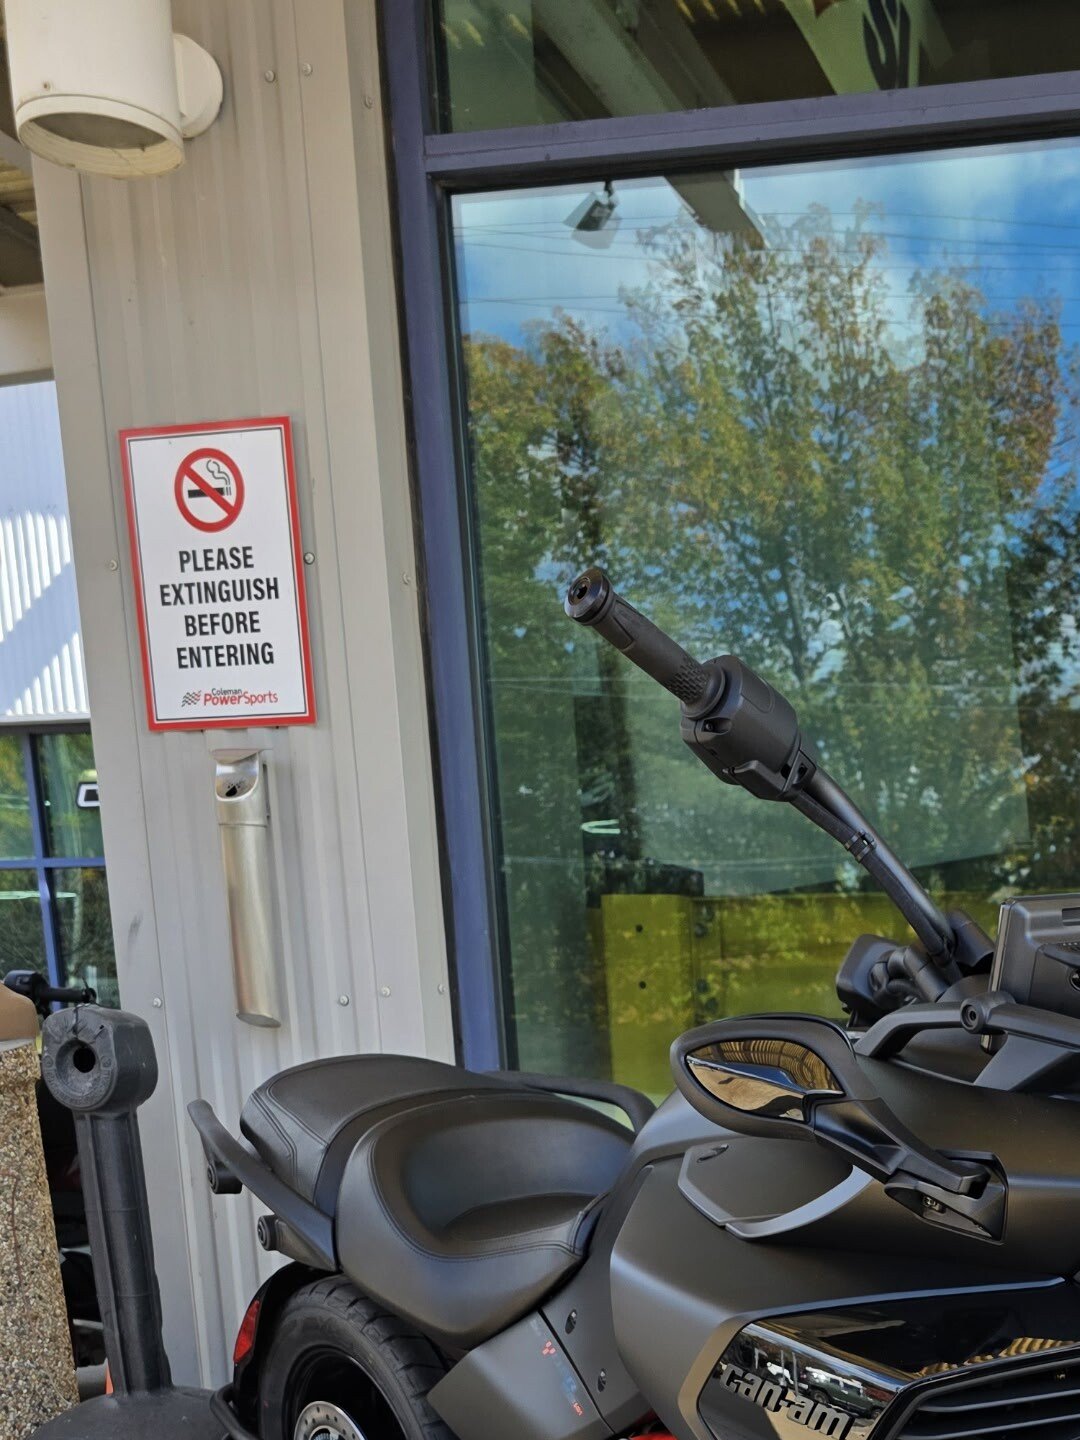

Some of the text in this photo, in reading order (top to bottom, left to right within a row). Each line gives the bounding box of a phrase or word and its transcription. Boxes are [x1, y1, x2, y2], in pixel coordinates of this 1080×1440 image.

[178, 546, 254, 573] PLEASE
[159, 577, 280, 606] EXTINGUISH
[184, 611, 261, 637] BEFORE
[176, 642, 274, 669] ENTERING
[203, 690, 278, 706] PowerSports
[211, 687, 242, 697] Coleman
